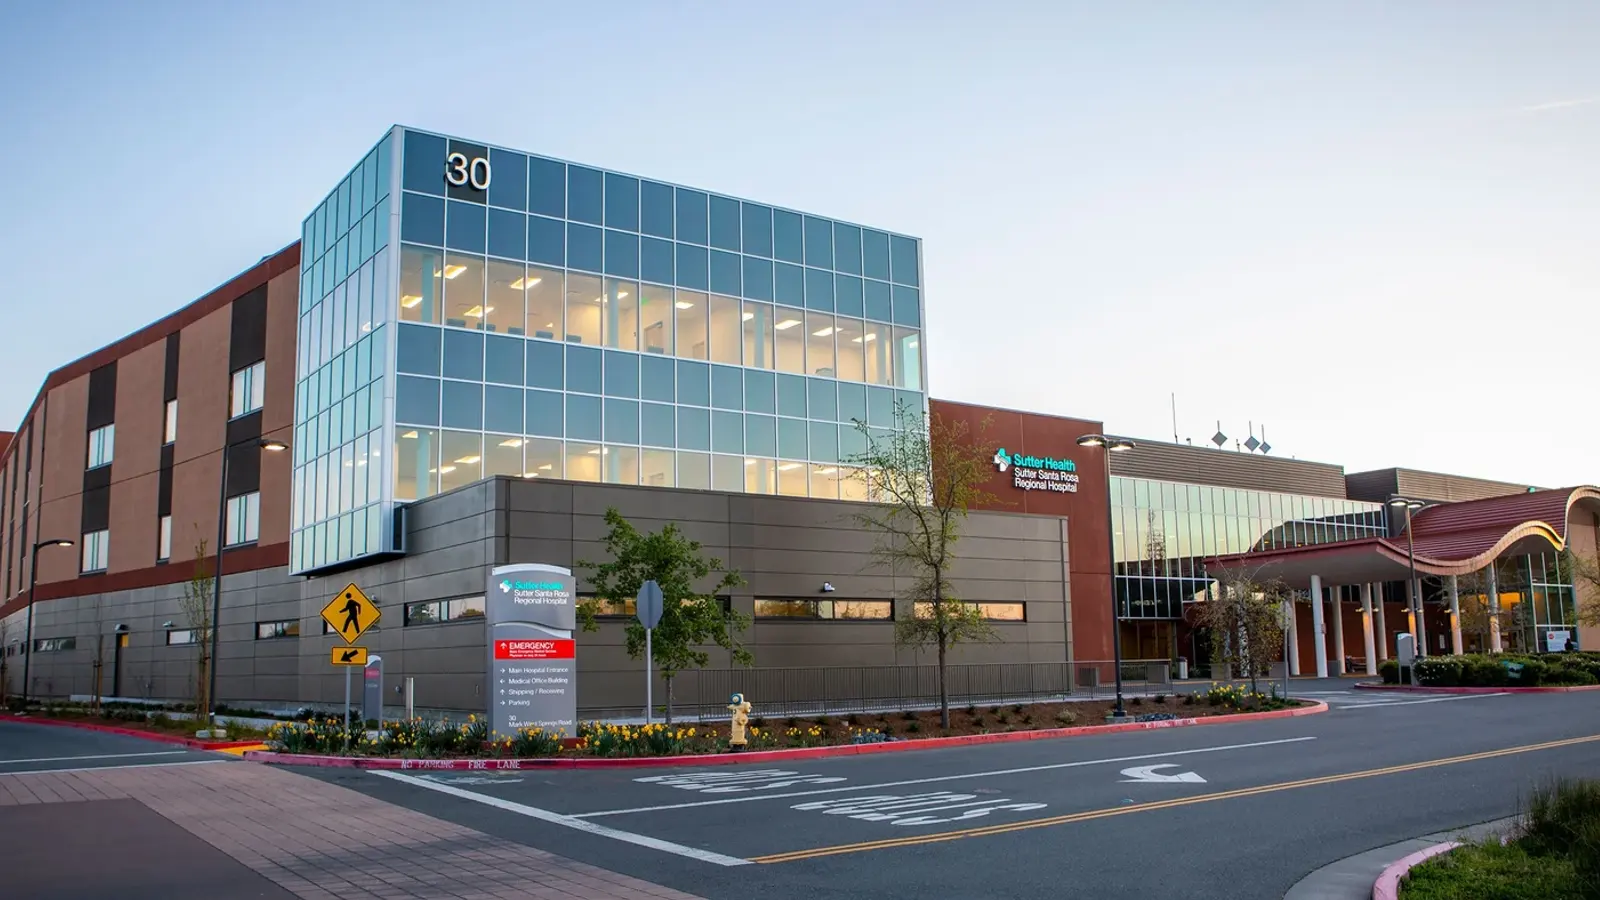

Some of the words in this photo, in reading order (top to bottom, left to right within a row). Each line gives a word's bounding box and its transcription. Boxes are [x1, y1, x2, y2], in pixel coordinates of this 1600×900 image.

[446, 152, 492, 190] 30
[1014, 453, 1045, 468] Sutter
[1045, 456, 1076, 472] Health
[1014, 467, 1037, 479] Sutter
[1038, 469, 1059, 481] Santa
[1060, 471, 1079, 482] Rosa
[1015, 478, 1047, 490] Regional
[1048, 480, 1077, 493] Hospital
[515, 581, 538, 589] Sutter
[540, 582, 563, 590] Health
[514, 589, 534, 597] Sutter
[534, 589, 553, 597] Santa
[553, 590, 569, 598] Rosa
[514, 597, 541, 606] Regional
[509, 642, 554, 650] EMERGENCY
[523, 667, 545, 675] Hospital
[547, 677, 568, 685] Building
[401, 760, 412, 769] NO
[418, 760, 454, 769] PARKING
[468, 760, 487, 769] FIRE
[496, 760, 521, 769] LANE
